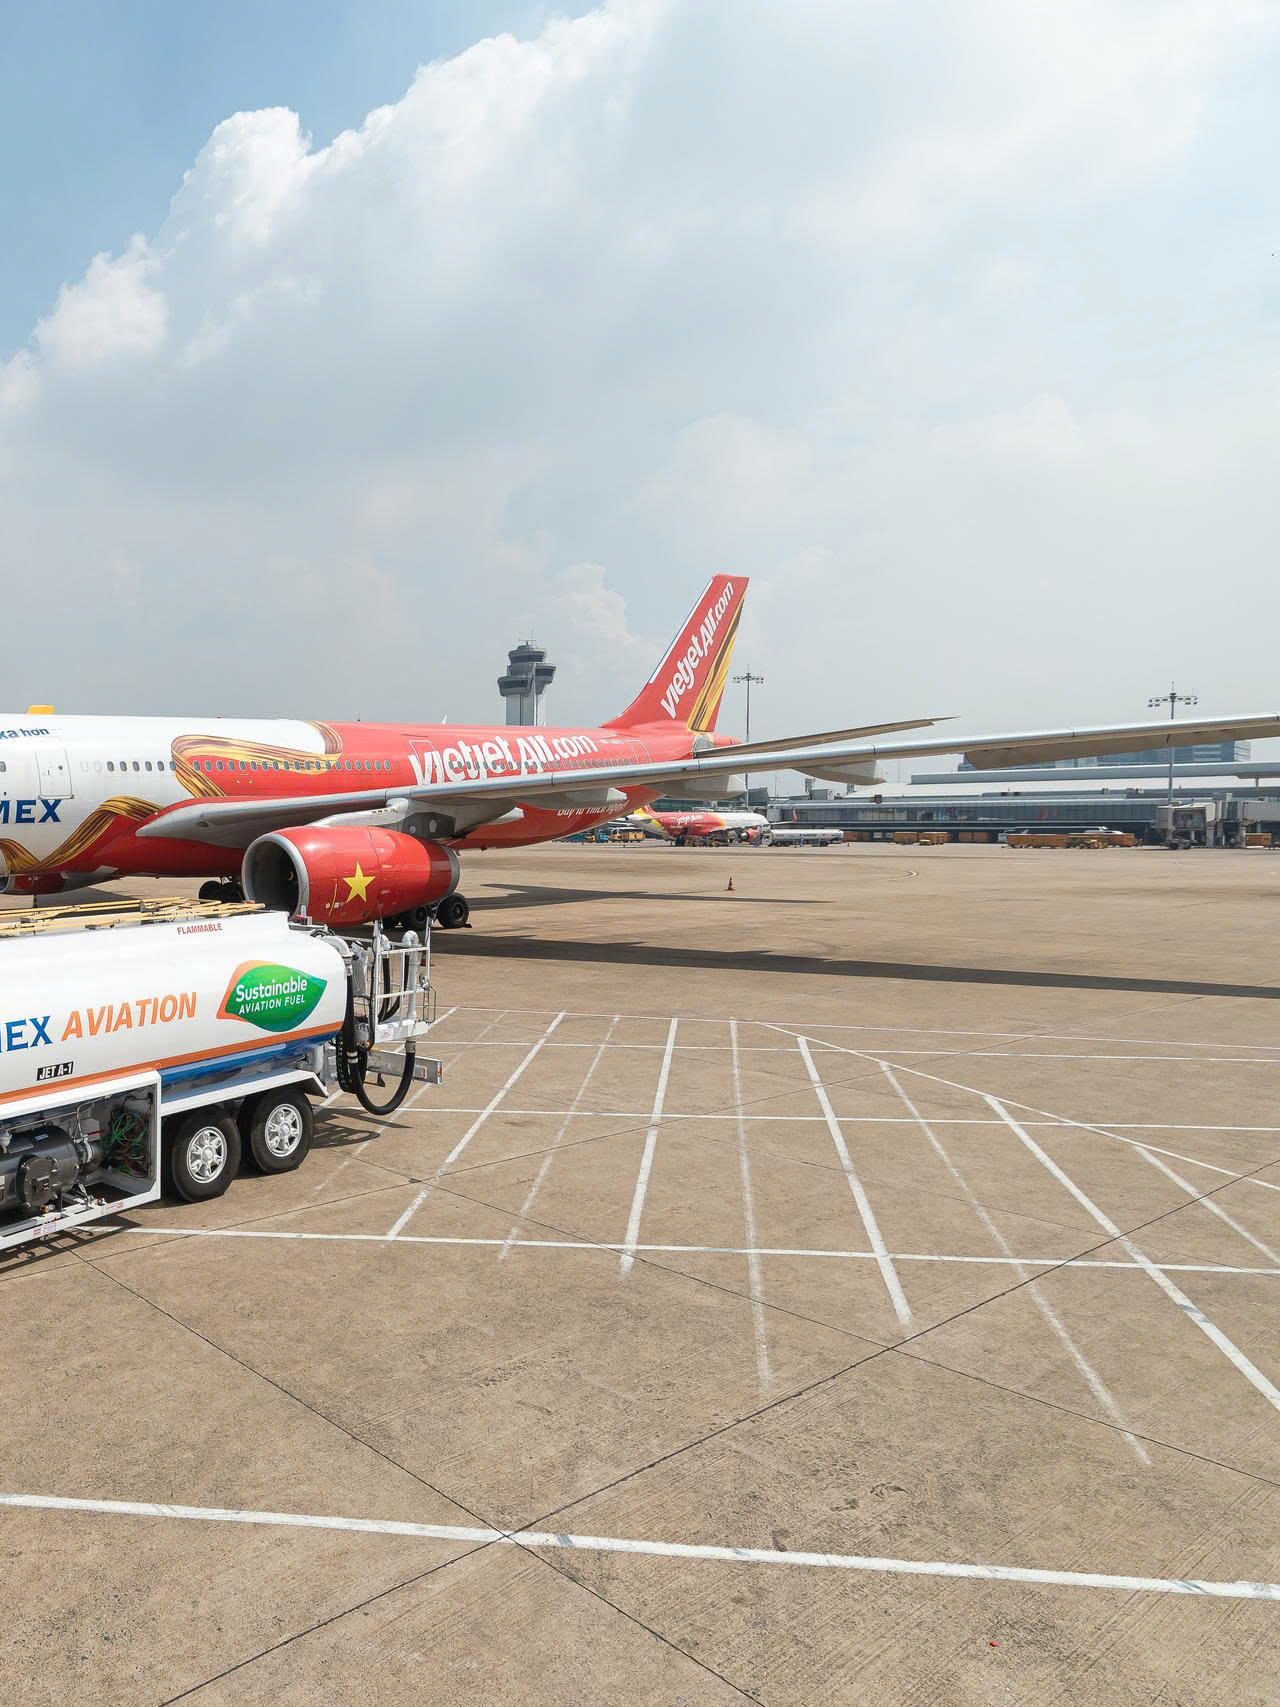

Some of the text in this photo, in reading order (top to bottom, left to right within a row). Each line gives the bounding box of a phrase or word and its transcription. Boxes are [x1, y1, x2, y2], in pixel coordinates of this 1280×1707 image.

[177, 922, 223, 935] FLAMMABLE
[235, 975, 308, 1002] Sustainable
[239, 994, 305, 1015] AVIATION FUEL
[61, 991, 197, 1040] AVIATION
[40, 1062, 73, 1079] JET A-1
